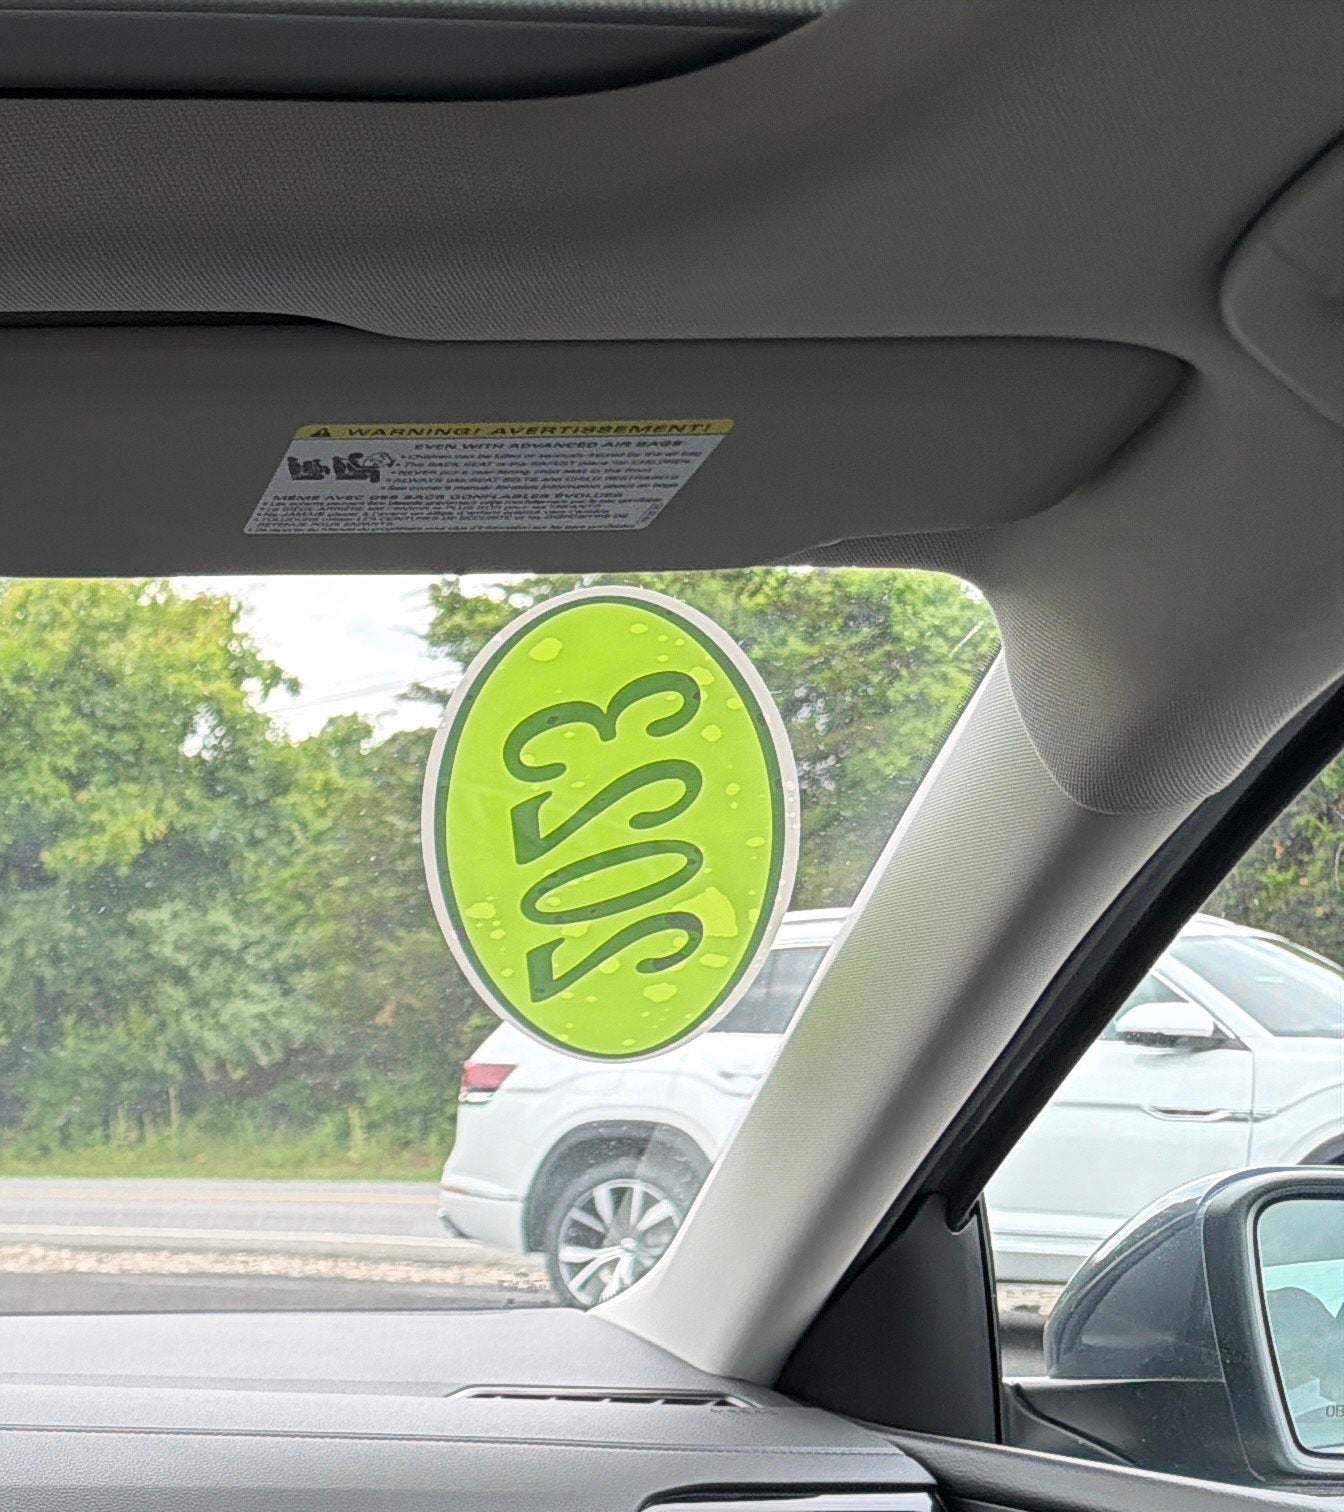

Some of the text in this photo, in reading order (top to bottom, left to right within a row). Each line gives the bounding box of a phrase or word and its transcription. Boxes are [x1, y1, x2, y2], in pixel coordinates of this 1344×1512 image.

[348, 424, 711, 436] WARNING! AVERTISSEMENT!
[509, 441, 598, 449] ADVANCED
